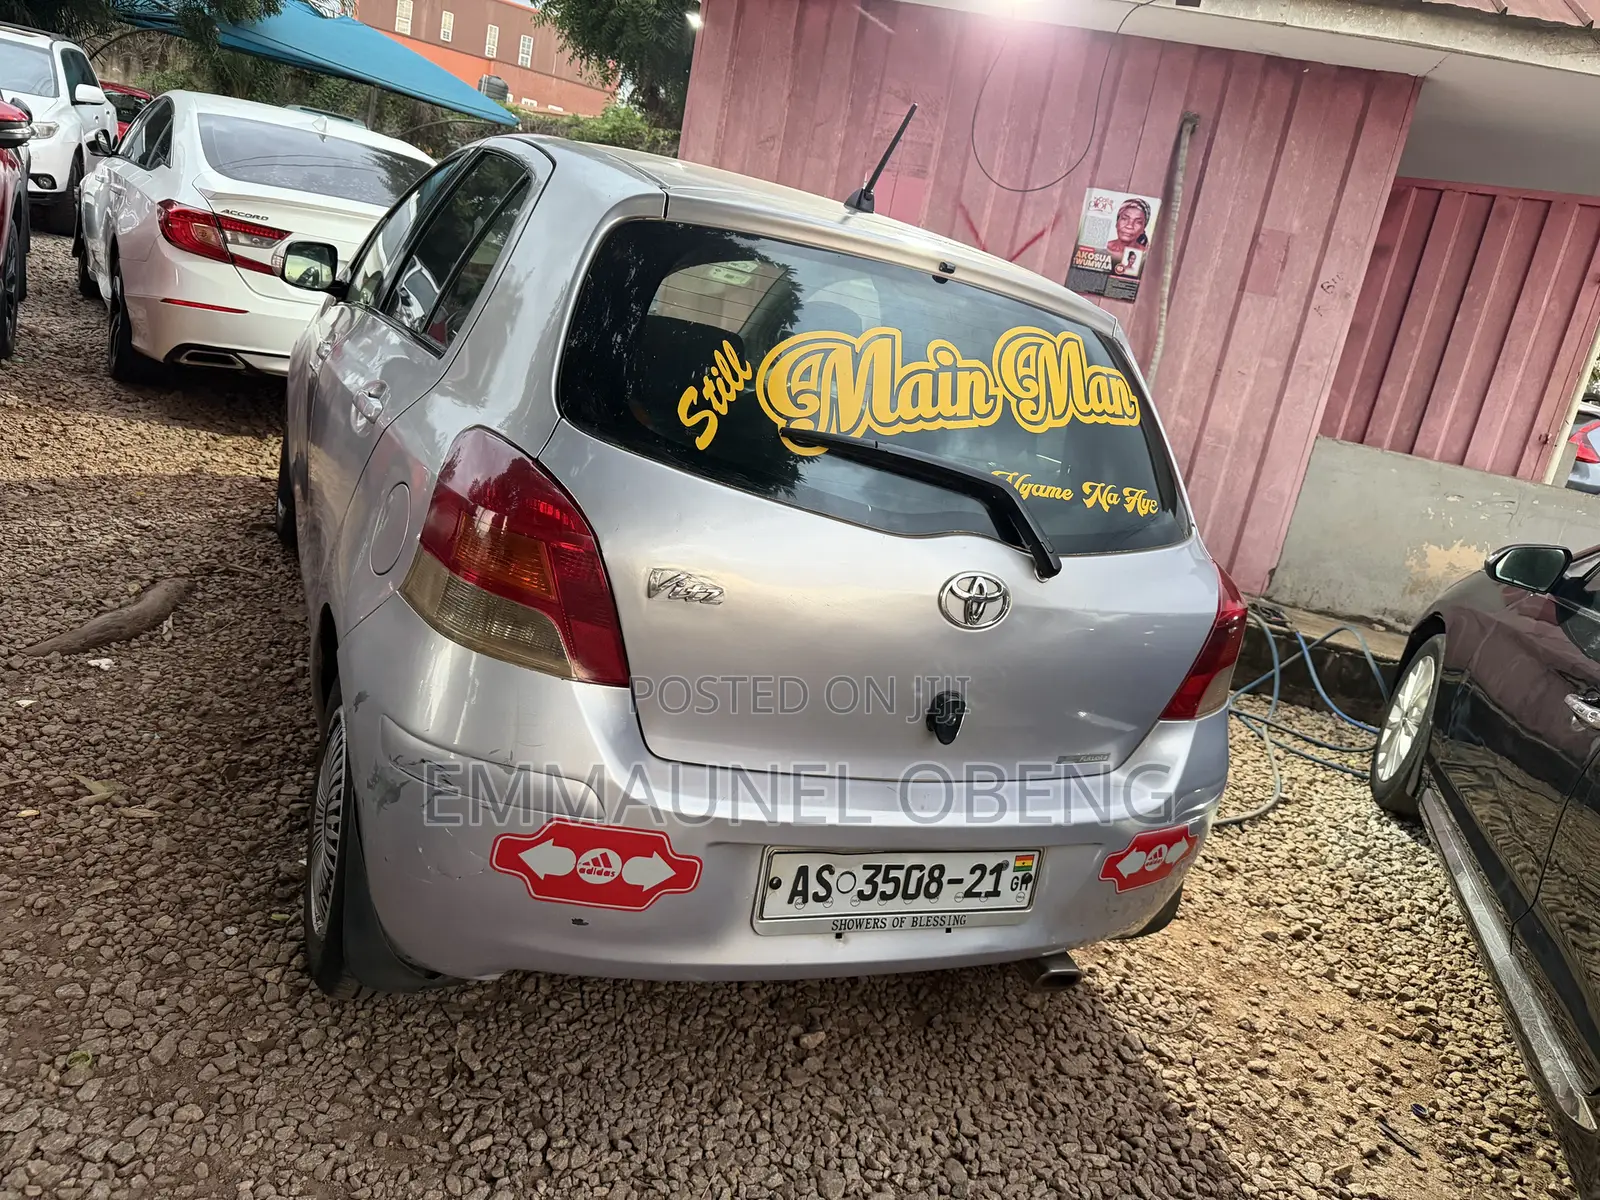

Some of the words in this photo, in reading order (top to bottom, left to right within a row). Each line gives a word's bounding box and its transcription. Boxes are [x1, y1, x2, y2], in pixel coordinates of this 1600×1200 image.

[220, 209, 269, 221] ACCORD
[1075, 250, 1111, 263] AKOSUA
[677, 339, 752, 450] Still
[756, 326, 1003, 456] Main
[992, 326, 1140, 433] Man
[1081, 481, 1120, 513] Na
[579, 867, 616, 878] adidas
[788, 864, 836, 904] AS
[857, 862, 1004, 901] 3508-21
[831, 917, 887, 932] SHOWERS
[892, 916, 906, 929] OF
[911, 914, 967, 928] BLESSING
